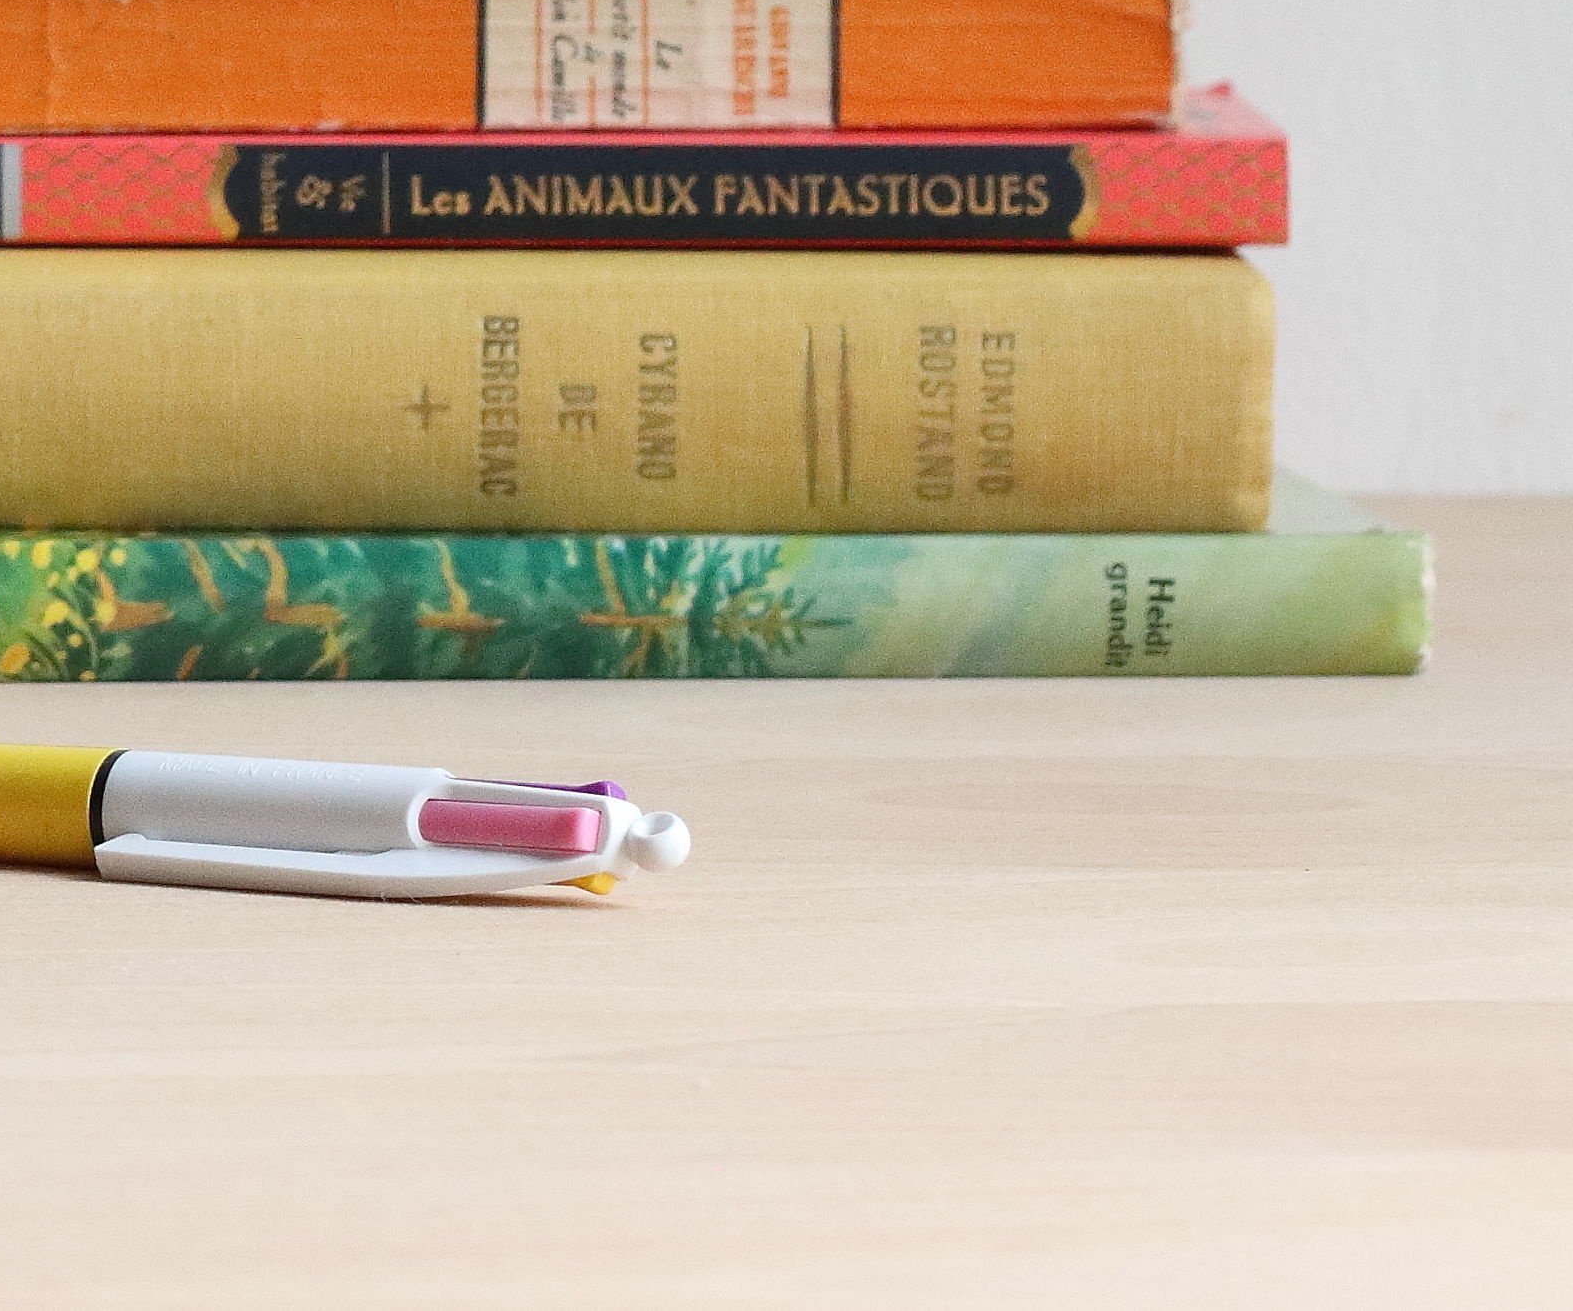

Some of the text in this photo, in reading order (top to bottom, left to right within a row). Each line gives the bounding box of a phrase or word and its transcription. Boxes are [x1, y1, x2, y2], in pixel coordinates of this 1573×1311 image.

[409, 175, 1050, 219] Les ANIMAUX FANTASTIQUES
[481, 315, 520, 498] BERGERAC
[558, 383, 598, 433] DE
[638, 332, 678, 480] CYRANO
[916, 325, 957, 501] ROSTAND
[978, 332, 1016, 496] EDMOND
[1146, 576, 1175, 656] Heidi
